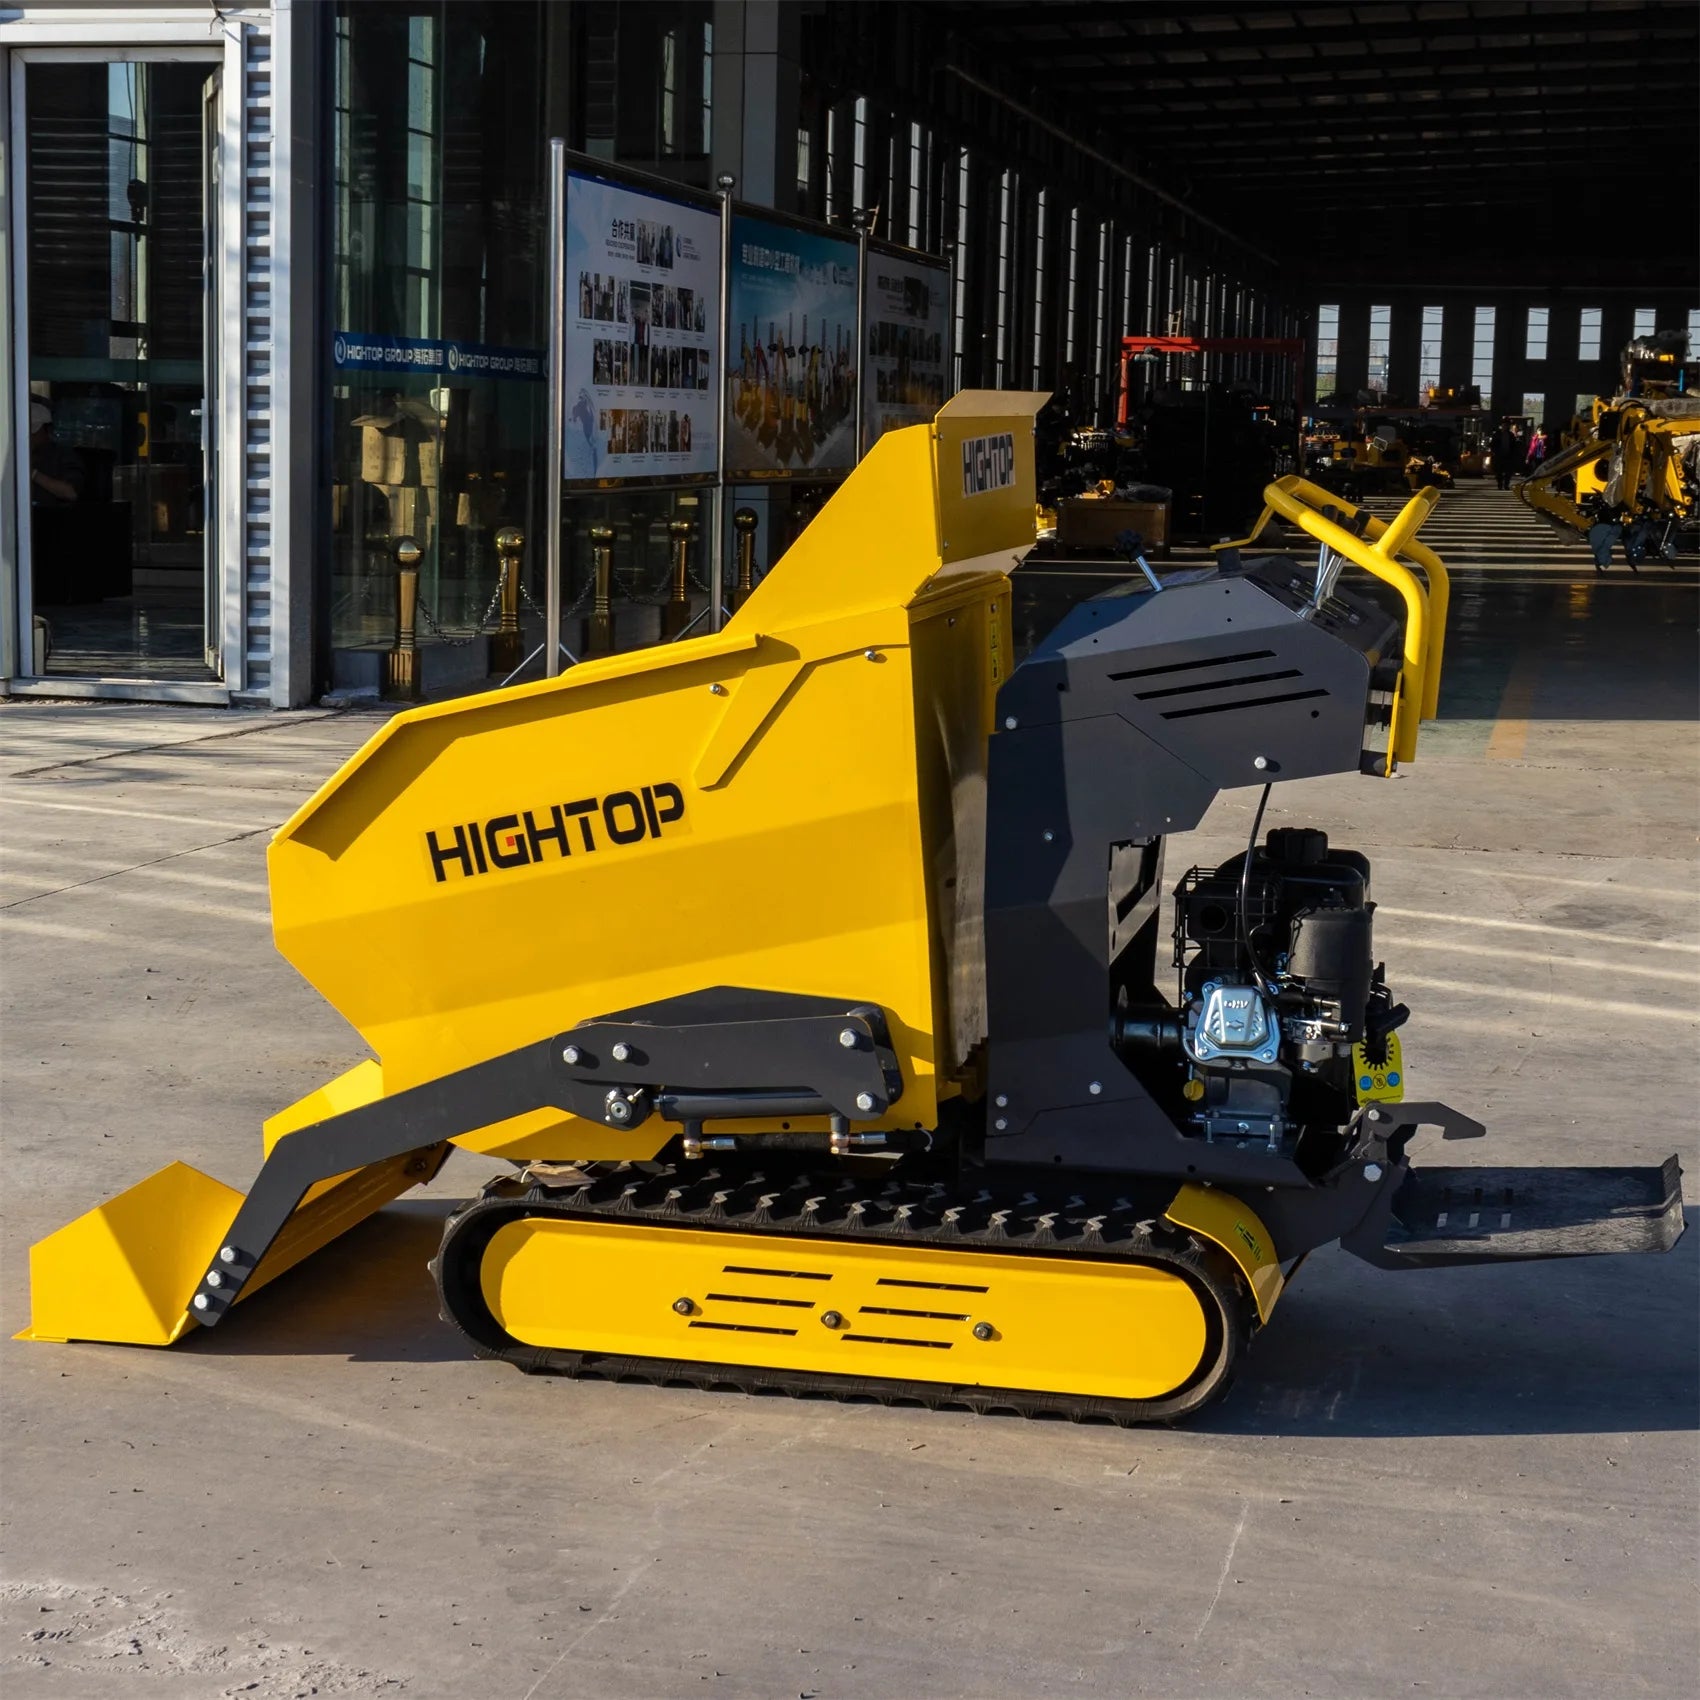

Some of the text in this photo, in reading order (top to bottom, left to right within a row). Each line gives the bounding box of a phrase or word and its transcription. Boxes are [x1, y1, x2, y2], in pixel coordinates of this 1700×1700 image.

[346, 344, 383, 361] HIGHTOP
[385, 347, 413, 363] GROUP
[458, 353, 489, 369] HIGHTOP
[490, 355, 513, 371] GROUP
[962, 434, 1014, 495] HIGHTOP
[425, 781, 685, 882] HIGHTOP
